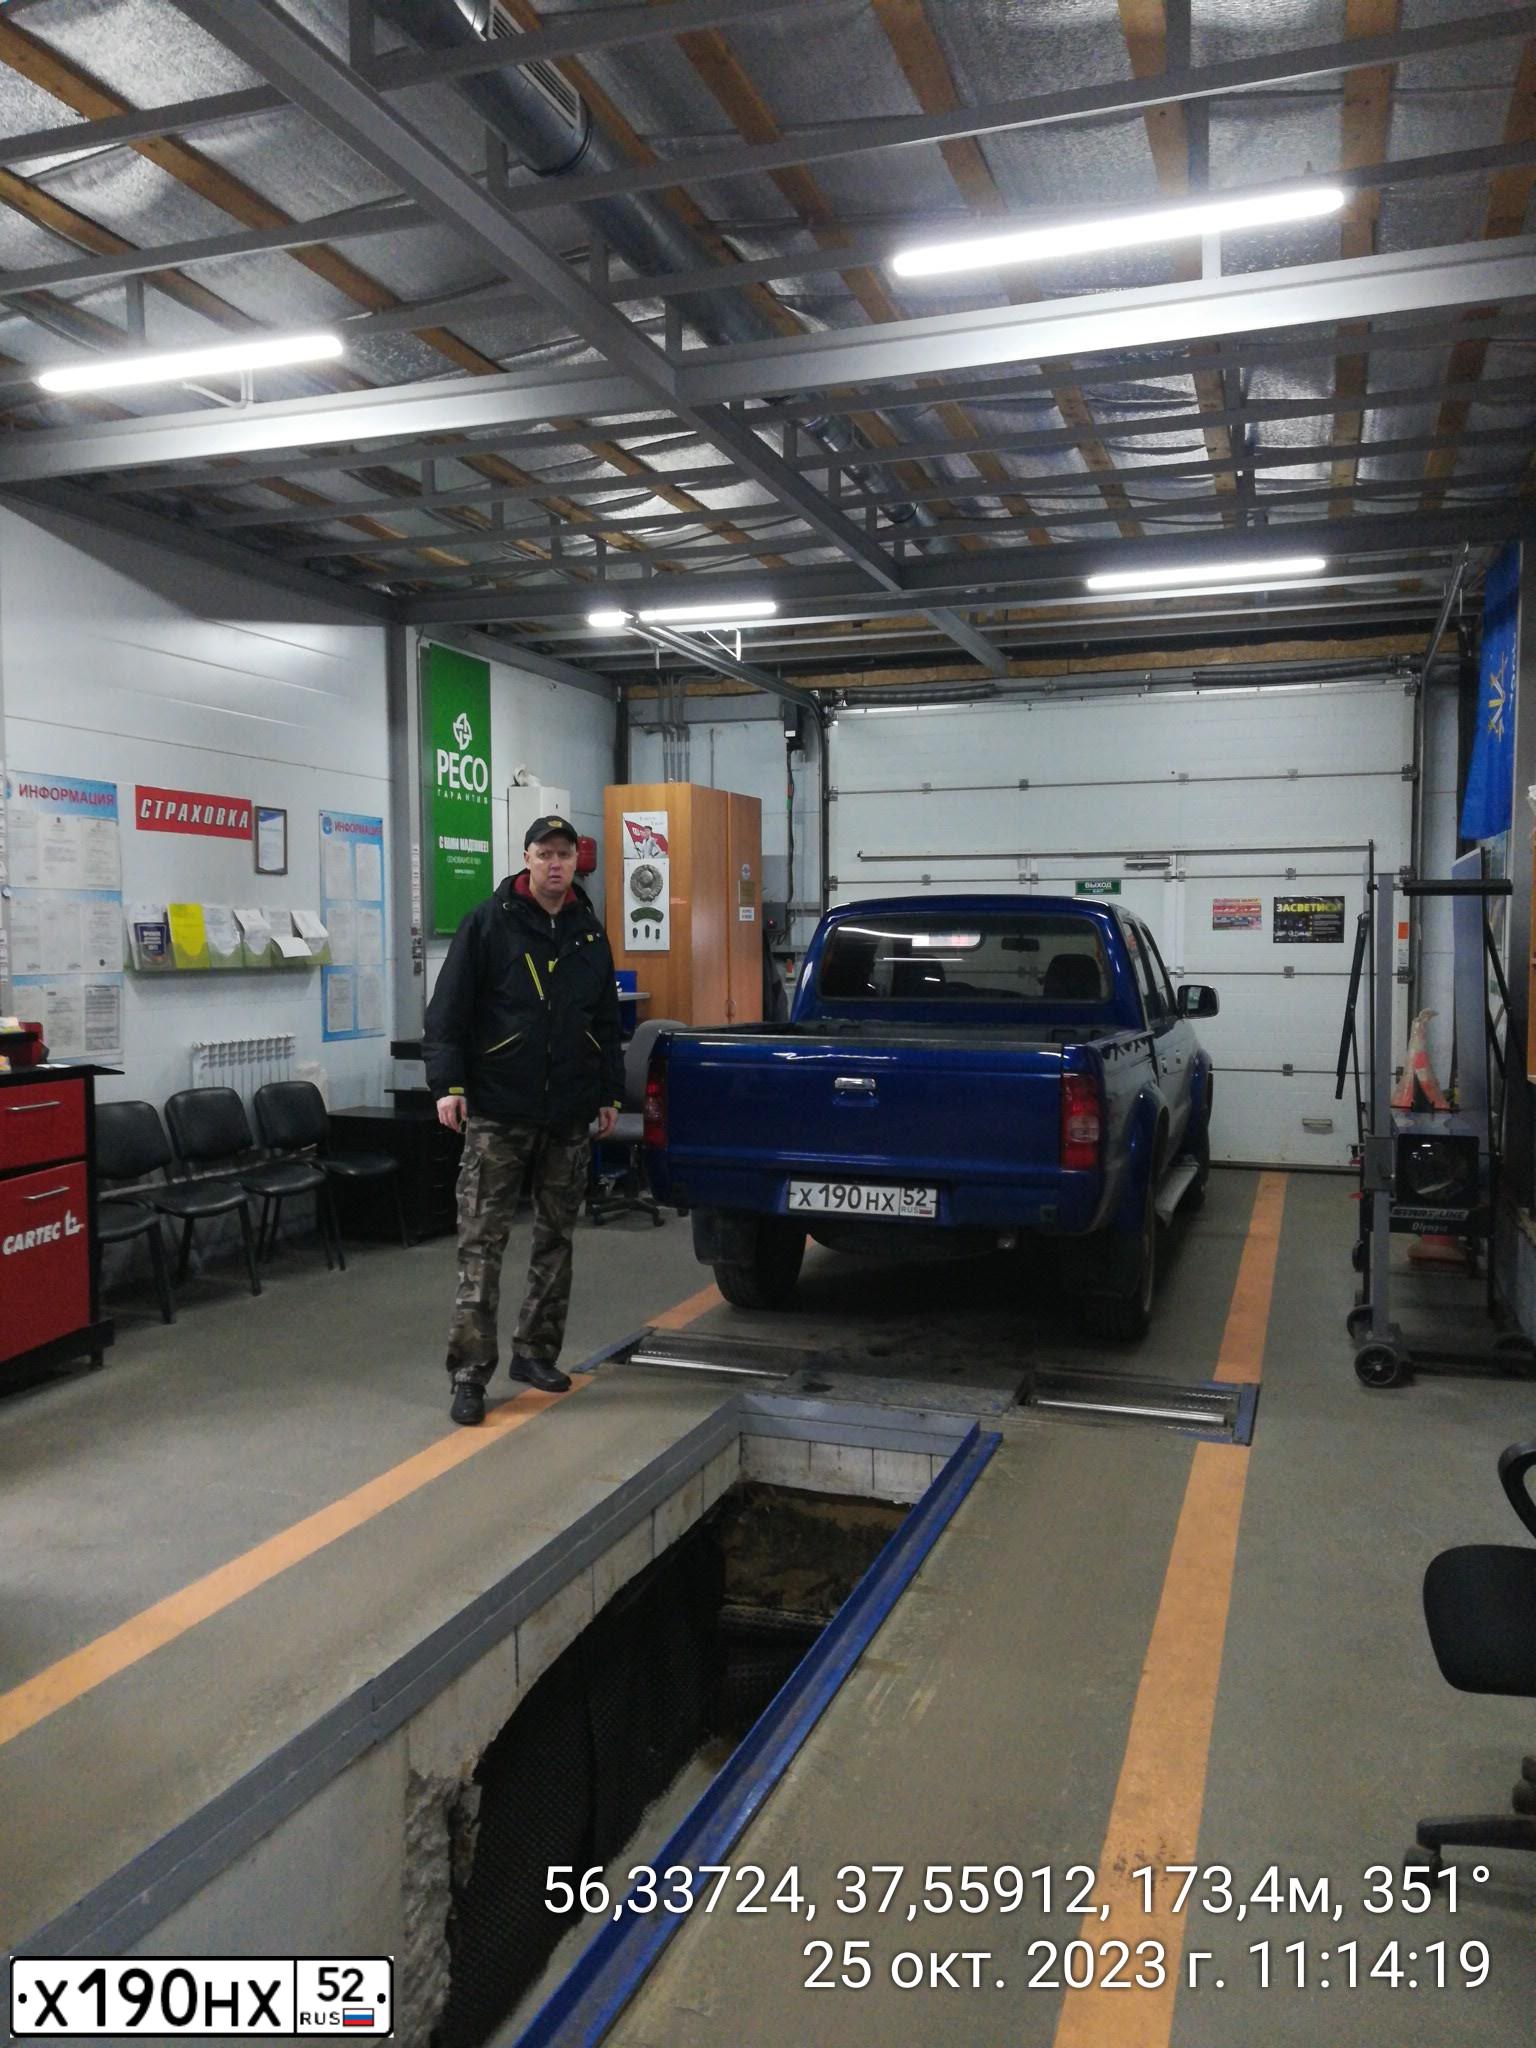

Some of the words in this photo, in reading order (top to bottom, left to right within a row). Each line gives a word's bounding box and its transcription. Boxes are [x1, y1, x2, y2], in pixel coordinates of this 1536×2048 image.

[437, 749, 489, 793] РЕСО
[19, 784, 114, 806] ИНФОРМАЦИЯ
[140, 799, 249, 829] СТРАХОВКА
[1084, 880, 1113, 889] ВЫХОД
[903, 1187, 928, 1206] 52
[3, 1221, 61, 1256] CARTEC
